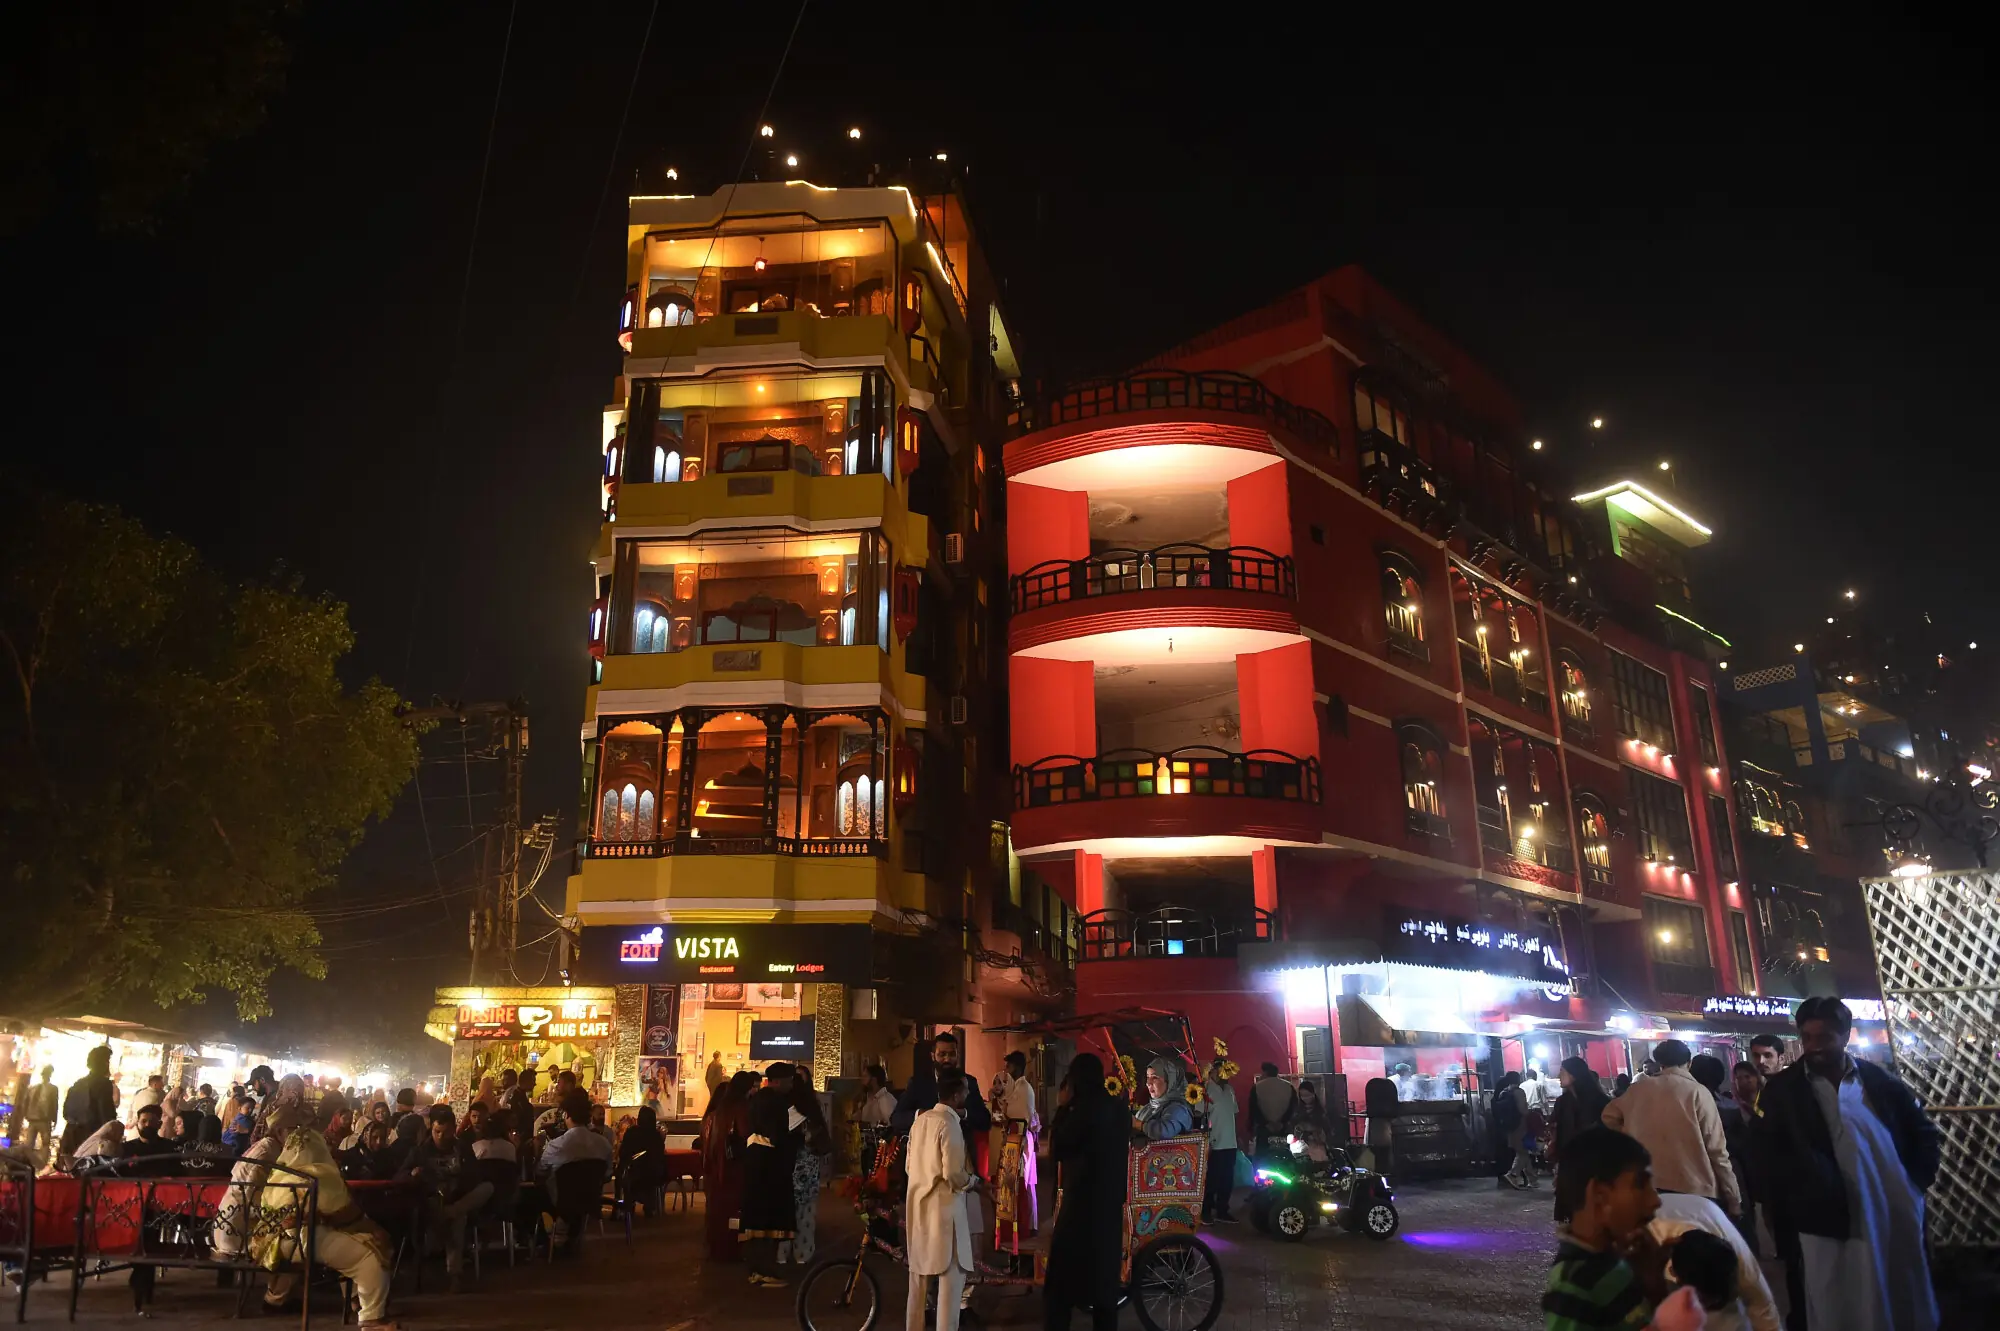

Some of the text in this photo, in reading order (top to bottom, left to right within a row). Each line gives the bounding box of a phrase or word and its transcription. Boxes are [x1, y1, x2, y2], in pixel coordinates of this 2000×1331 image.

[621, 937, 739, 959] FORT VISTA
[700, 965, 735, 973] Restaurant
[768, 963, 824, 973] Eatery Lodges
[459, 1006, 516, 1023] DESIRE
[589, 1006, 598, 1019] A
[549, 1023, 609, 1037] MUG CAFE
